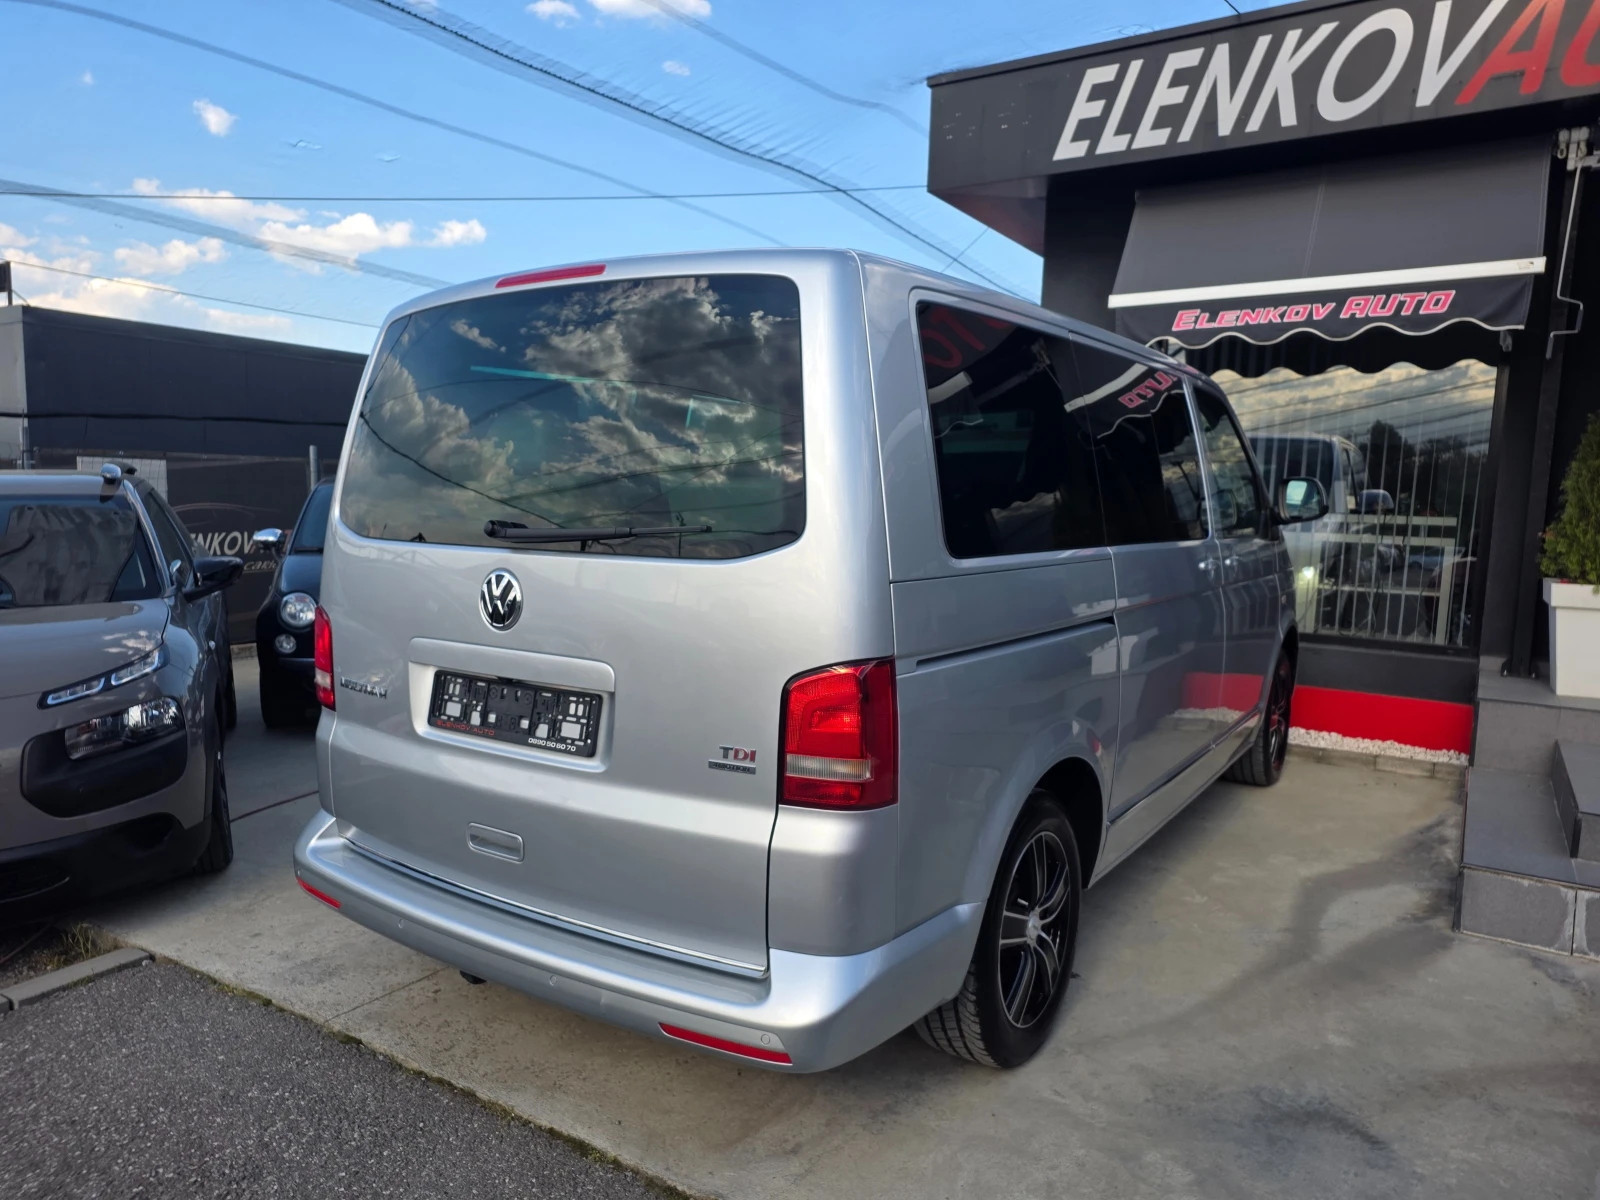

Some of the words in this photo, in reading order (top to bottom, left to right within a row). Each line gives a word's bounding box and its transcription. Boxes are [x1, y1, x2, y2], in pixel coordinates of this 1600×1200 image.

[1052, 0, 1508, 160] ELENKOV
[1172, 302, 1336, 331] ELENKOV
[1340, 290, 1456, 319] AUTO
[472, 727, 495, 736] AUTO
[719, 745, 757, 763] TDI
